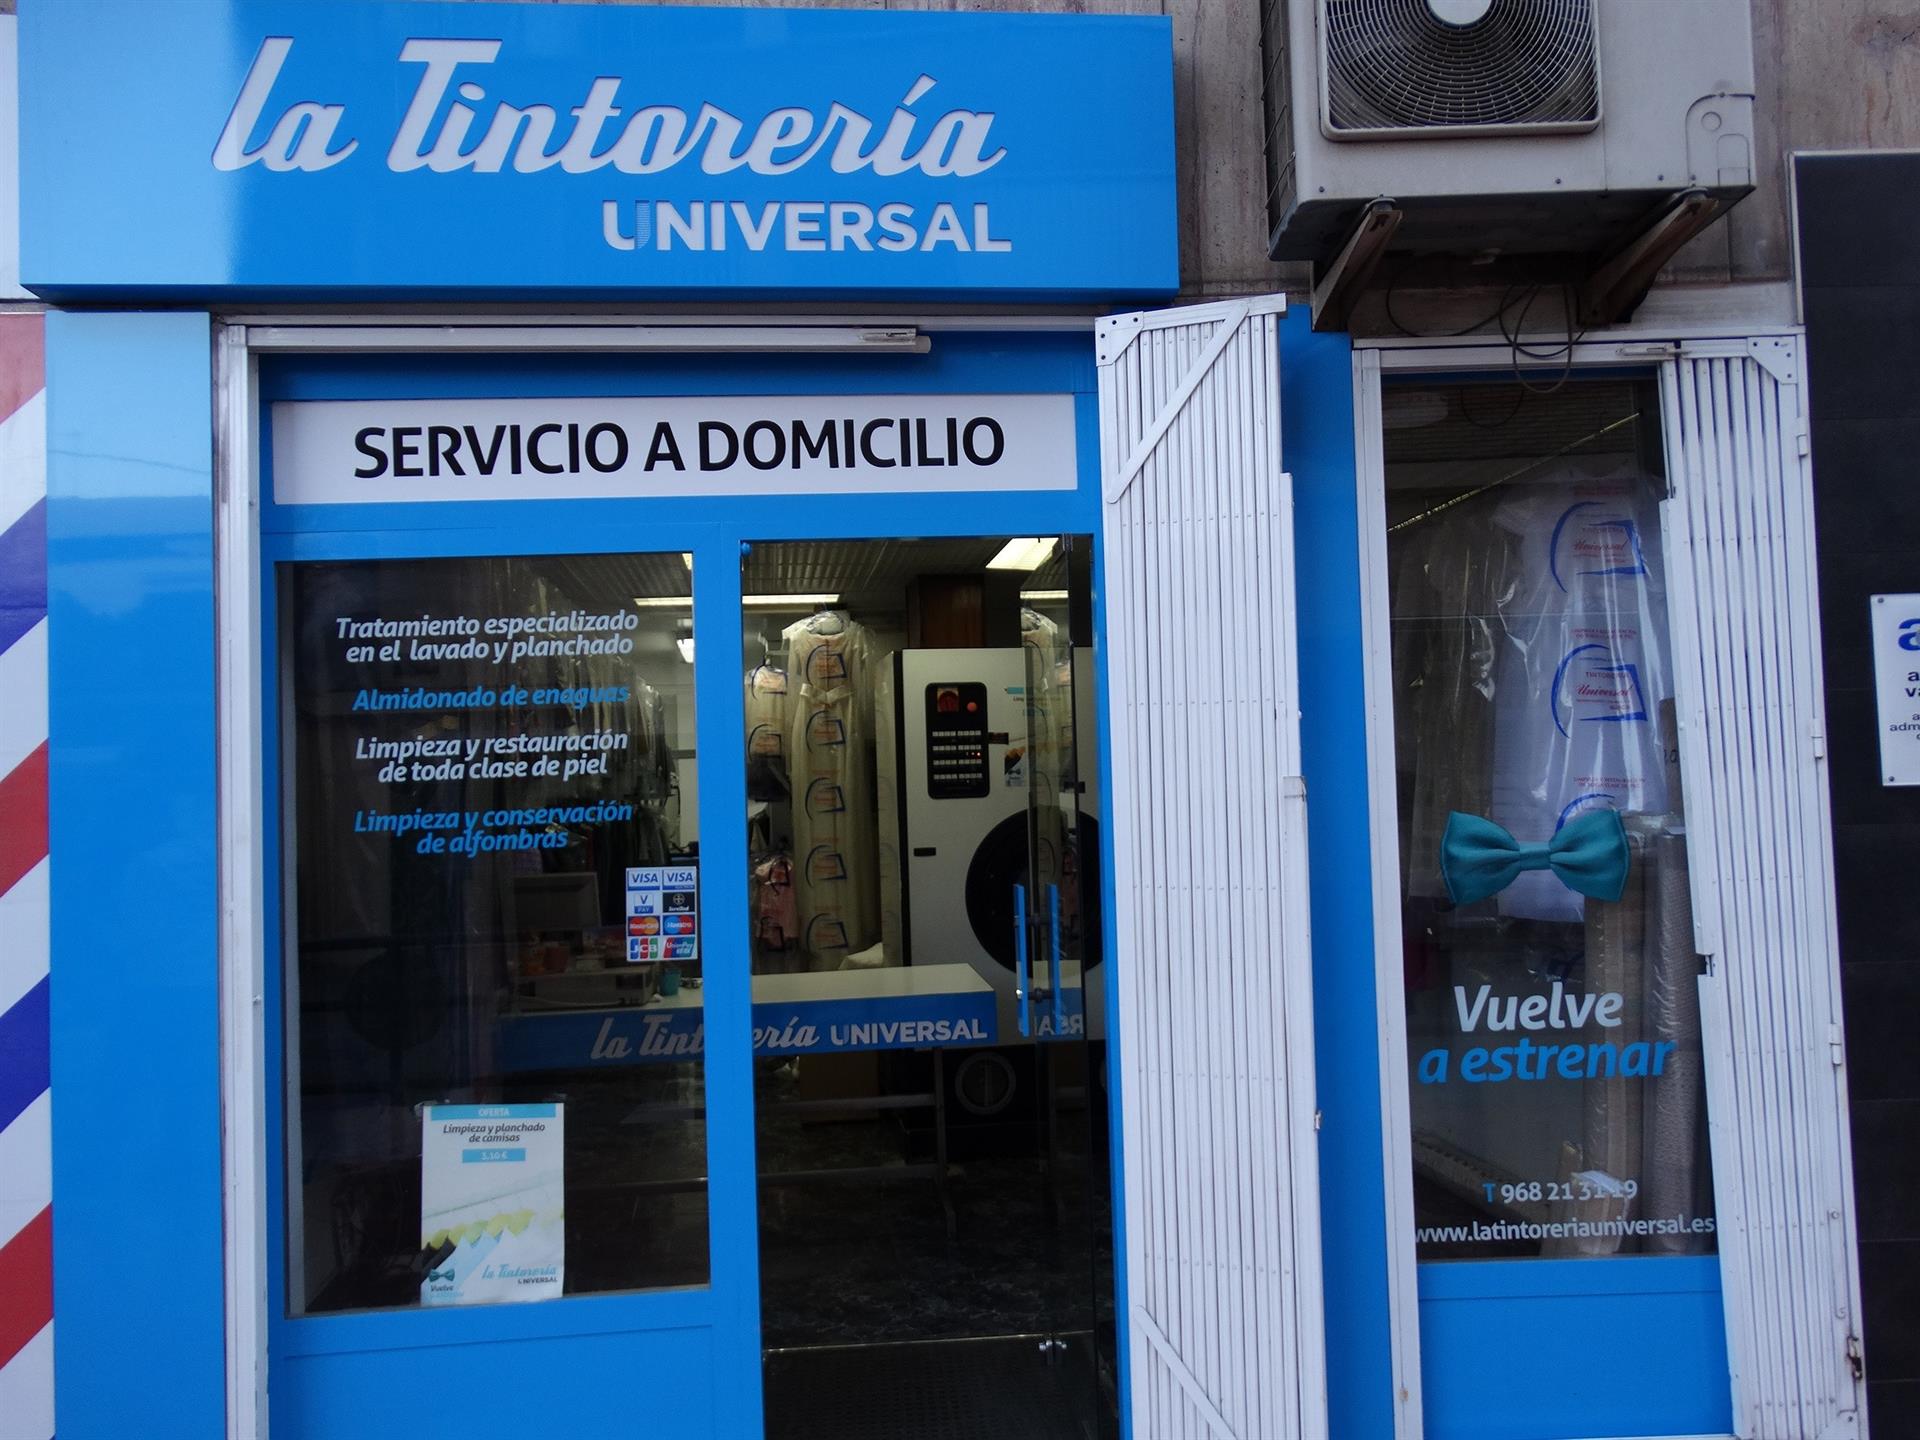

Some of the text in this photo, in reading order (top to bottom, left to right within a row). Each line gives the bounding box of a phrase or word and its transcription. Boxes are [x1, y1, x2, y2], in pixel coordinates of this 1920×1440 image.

[212, 36, 1007, 177] la Tintorería
[603, 200, 1011, 252] UNIVERSAL
[355, 416, 1004, 479] SERVICIO A DOMICILIO
[336, 609, 639, 640] Tratamiento especializado
[346, 633, 633, 664] en el lavado y planchado
[352, 684, 630, 711] Almidonado de enaguas
[356, 729, 628, 763] Limpieza y restauración
[378, 753, 608, 783] de toda clase de piel
[355, 800, 632, 837] Limpieza y conservación
[416, 828, 568, 858] de alfombras
[632, 873, 658, 883] VISA
[667, 872, 693, 882] VISA
[1454, 981, 1624, 1032] Vuelve
[590, 1016, 633, 1060] la
[830, 1018, 987, 1047] UNIVERSAL
[1418, 1037, 1677, 1085] a estrenar
[478, 1107, 510, 1117] OFERTA
[443, 1122, 545, 1136] Limpieza y planchado
[469, 1133, 520, 1143] de camisas
[1482, 1182, 1496, 1204] T
[1500, 1181, 1543, 1204] 968
[1547, 1182, 1573, 1202] 21
[1416, 1215, 1715, 1243] www.latintoreriauniversal.es
